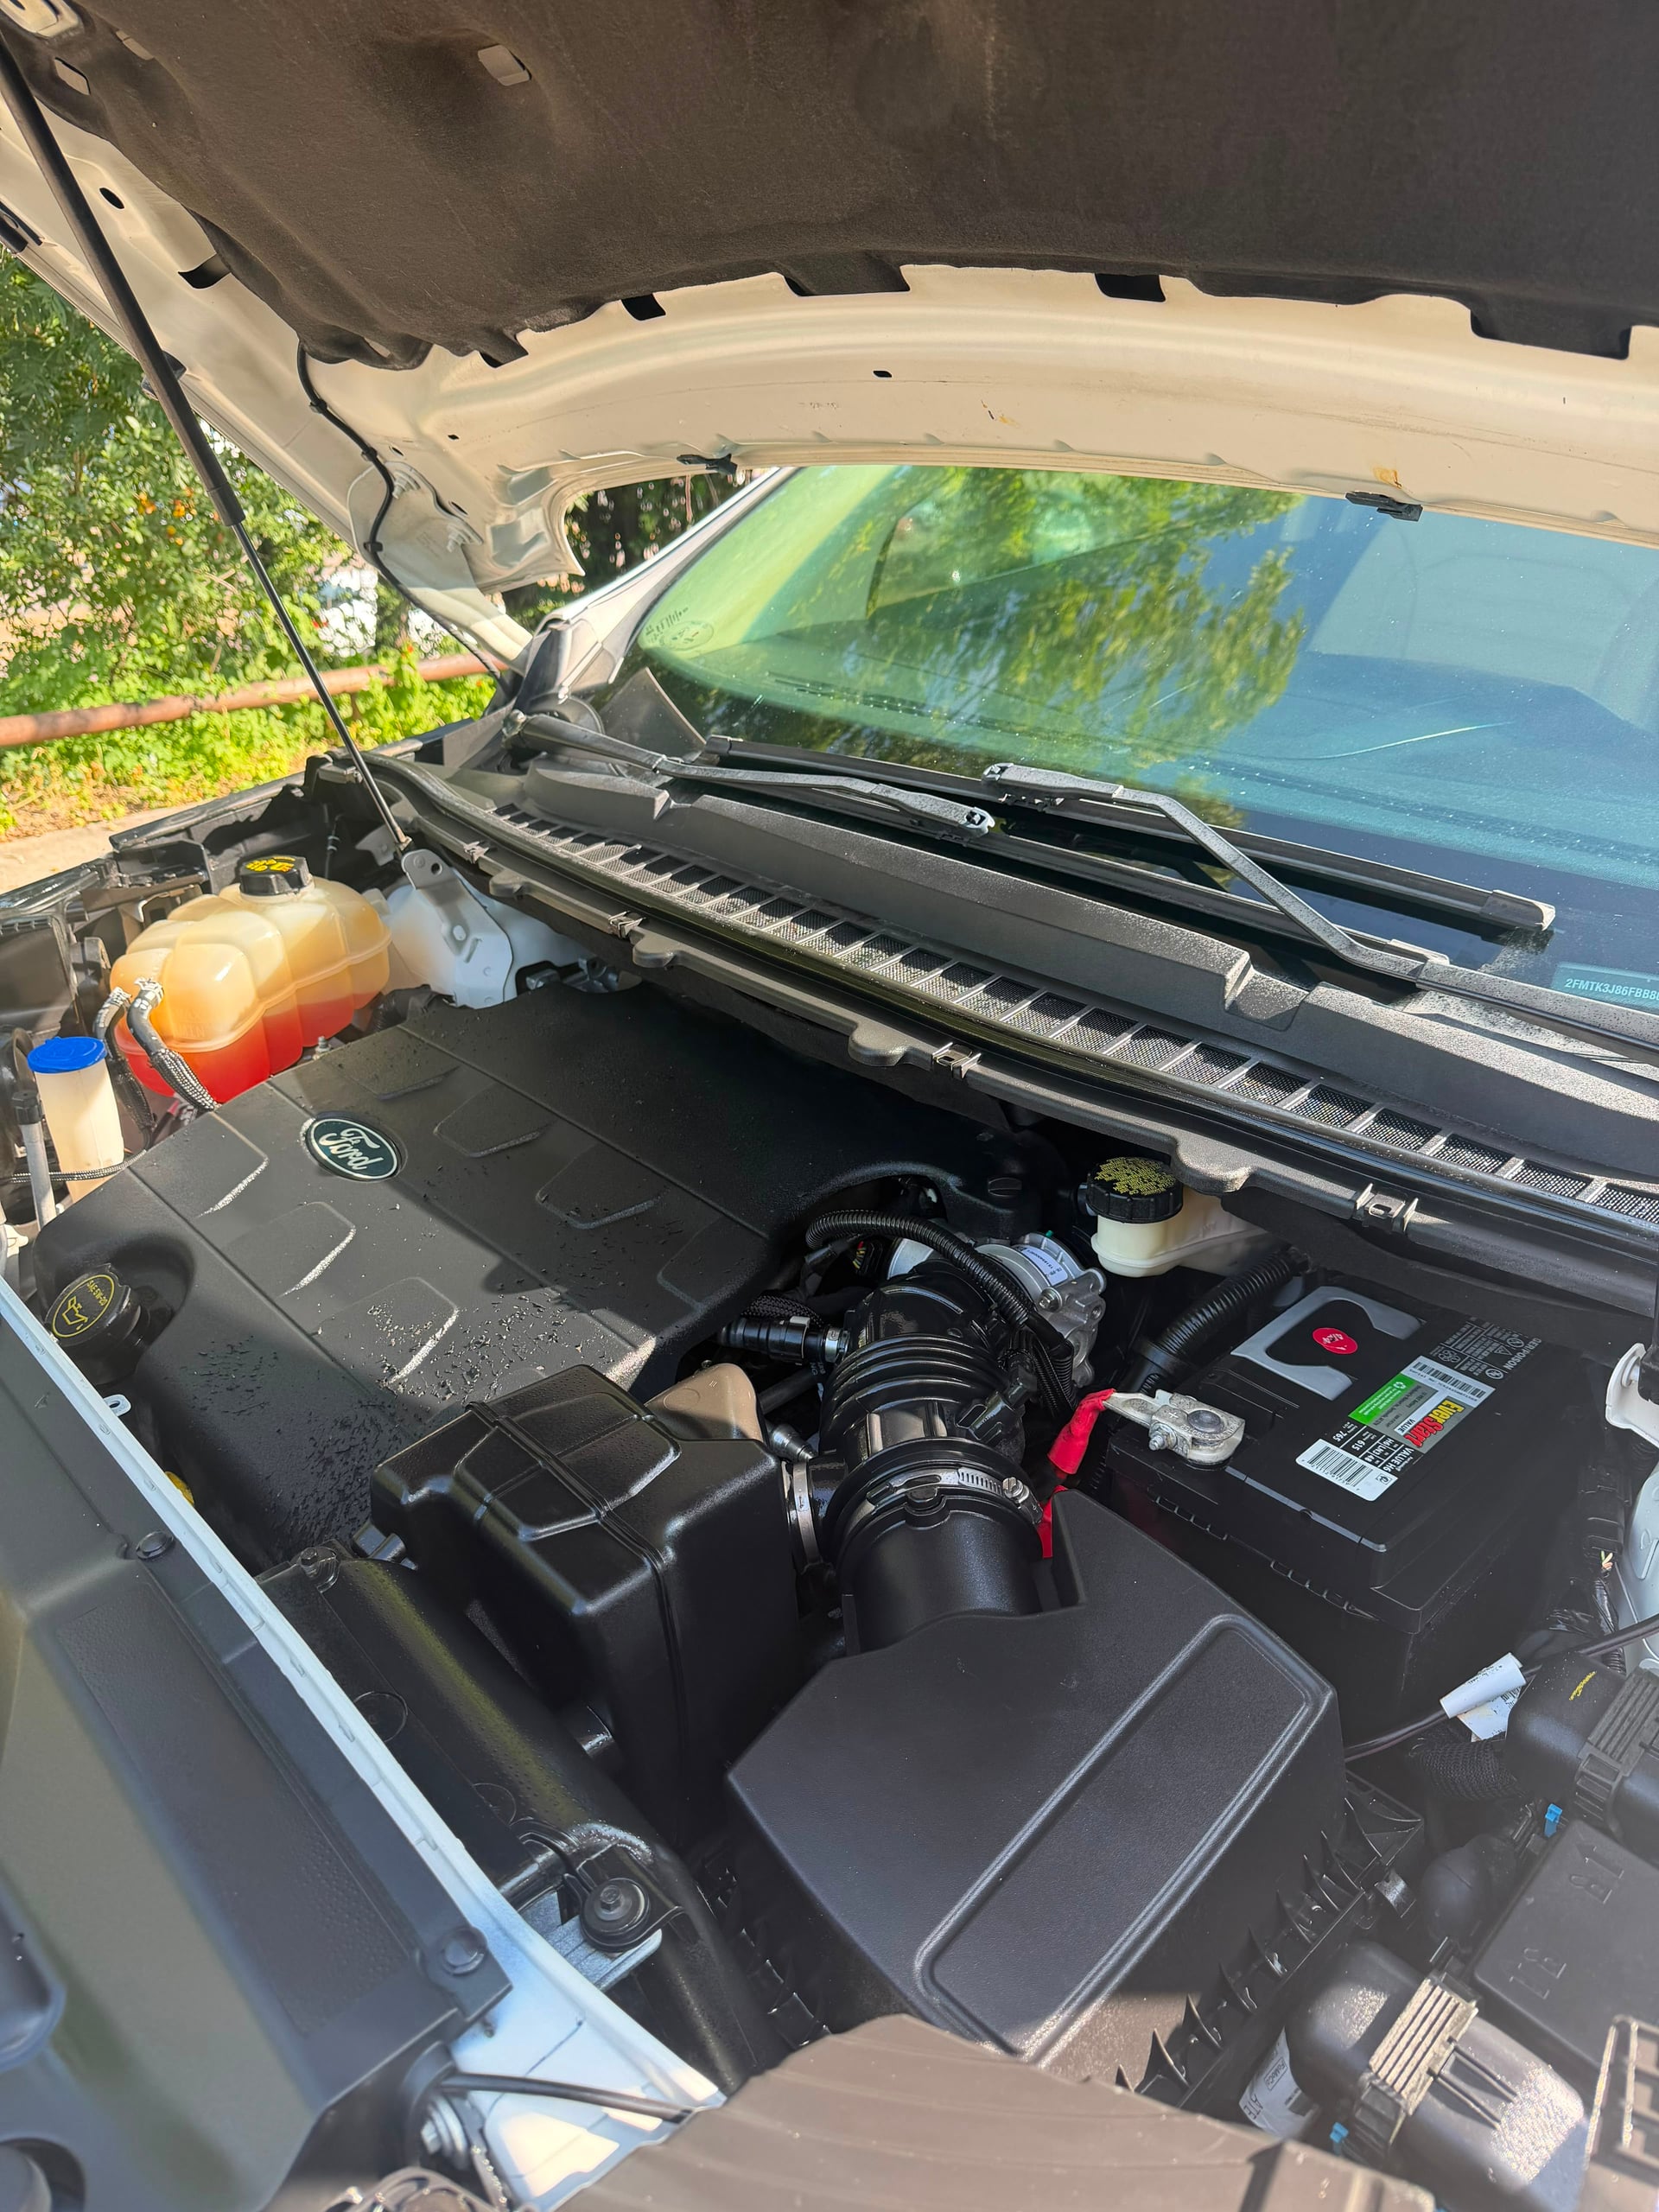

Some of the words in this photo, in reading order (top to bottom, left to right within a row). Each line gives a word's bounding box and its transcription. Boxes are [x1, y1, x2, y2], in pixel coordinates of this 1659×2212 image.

[318, 1128, 384, 1170] Ford
[1396, 1417, 1416, 1433] VALUE
[1403, 1398, 1465, 1448] EverStart
[1331, 1429, 1348, 1442] 765
[1382, 1437, 1395, 1446] H6
[1350, 1439, 1367, 1451] 615
[1363, 1453, 1376, 1463] 48
[1389, 1446, 1414, 1465] VALUE
[1381, 1461, 1396, 1472] H6
[1265, 2061, 1287, 2086] FoMoCo
